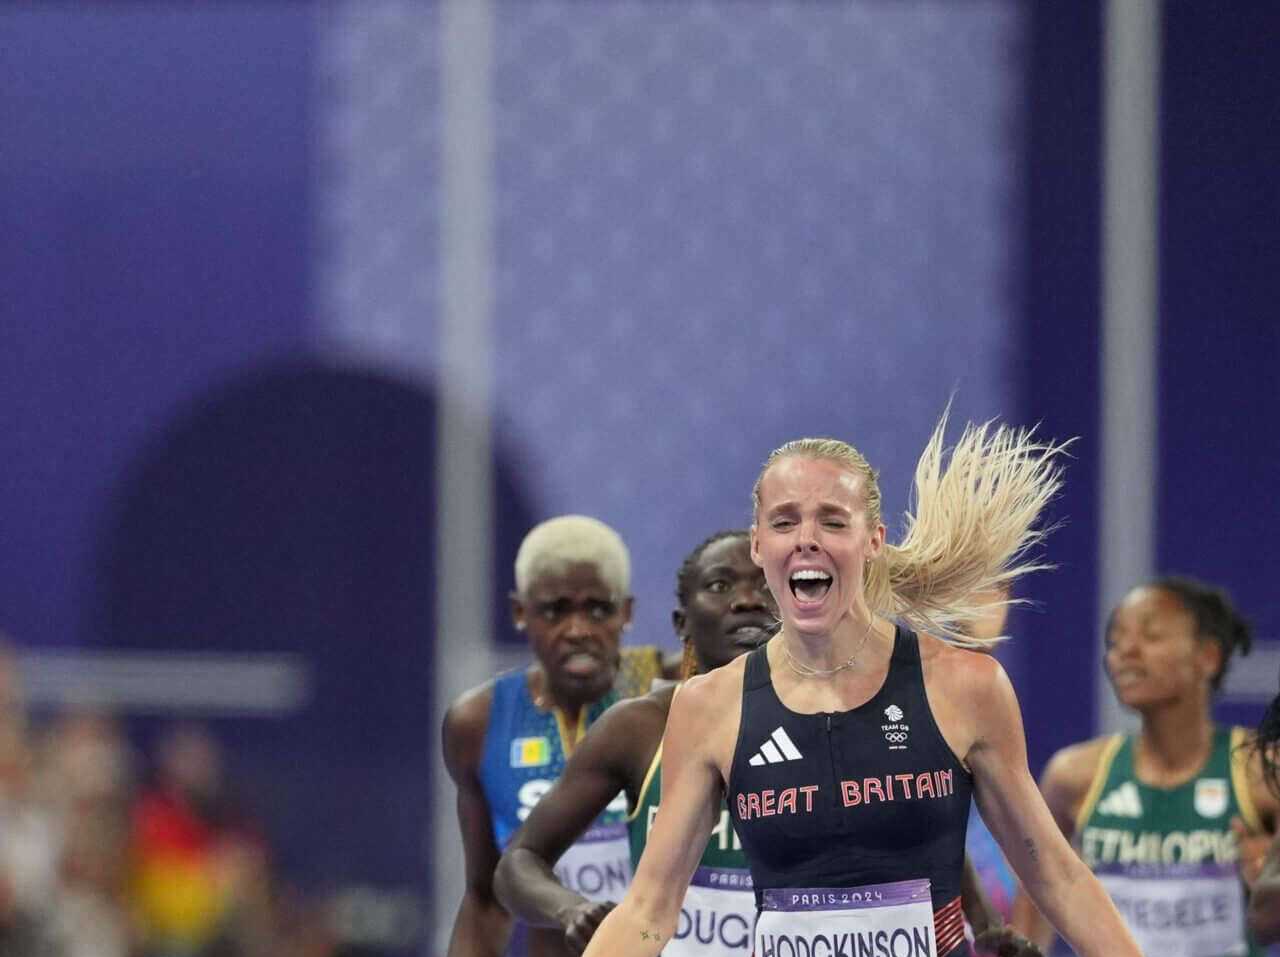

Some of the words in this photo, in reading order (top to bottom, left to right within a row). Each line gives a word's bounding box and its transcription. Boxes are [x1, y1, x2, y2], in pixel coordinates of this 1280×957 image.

[880, 723, 899, 731] TEAM
[736, 785, 819, 820] GREAT
[840, 768, 954, 808] BRITAIN
[792, 893, 836, 905] PARIS
[841, 890, 884, 904] 2024
